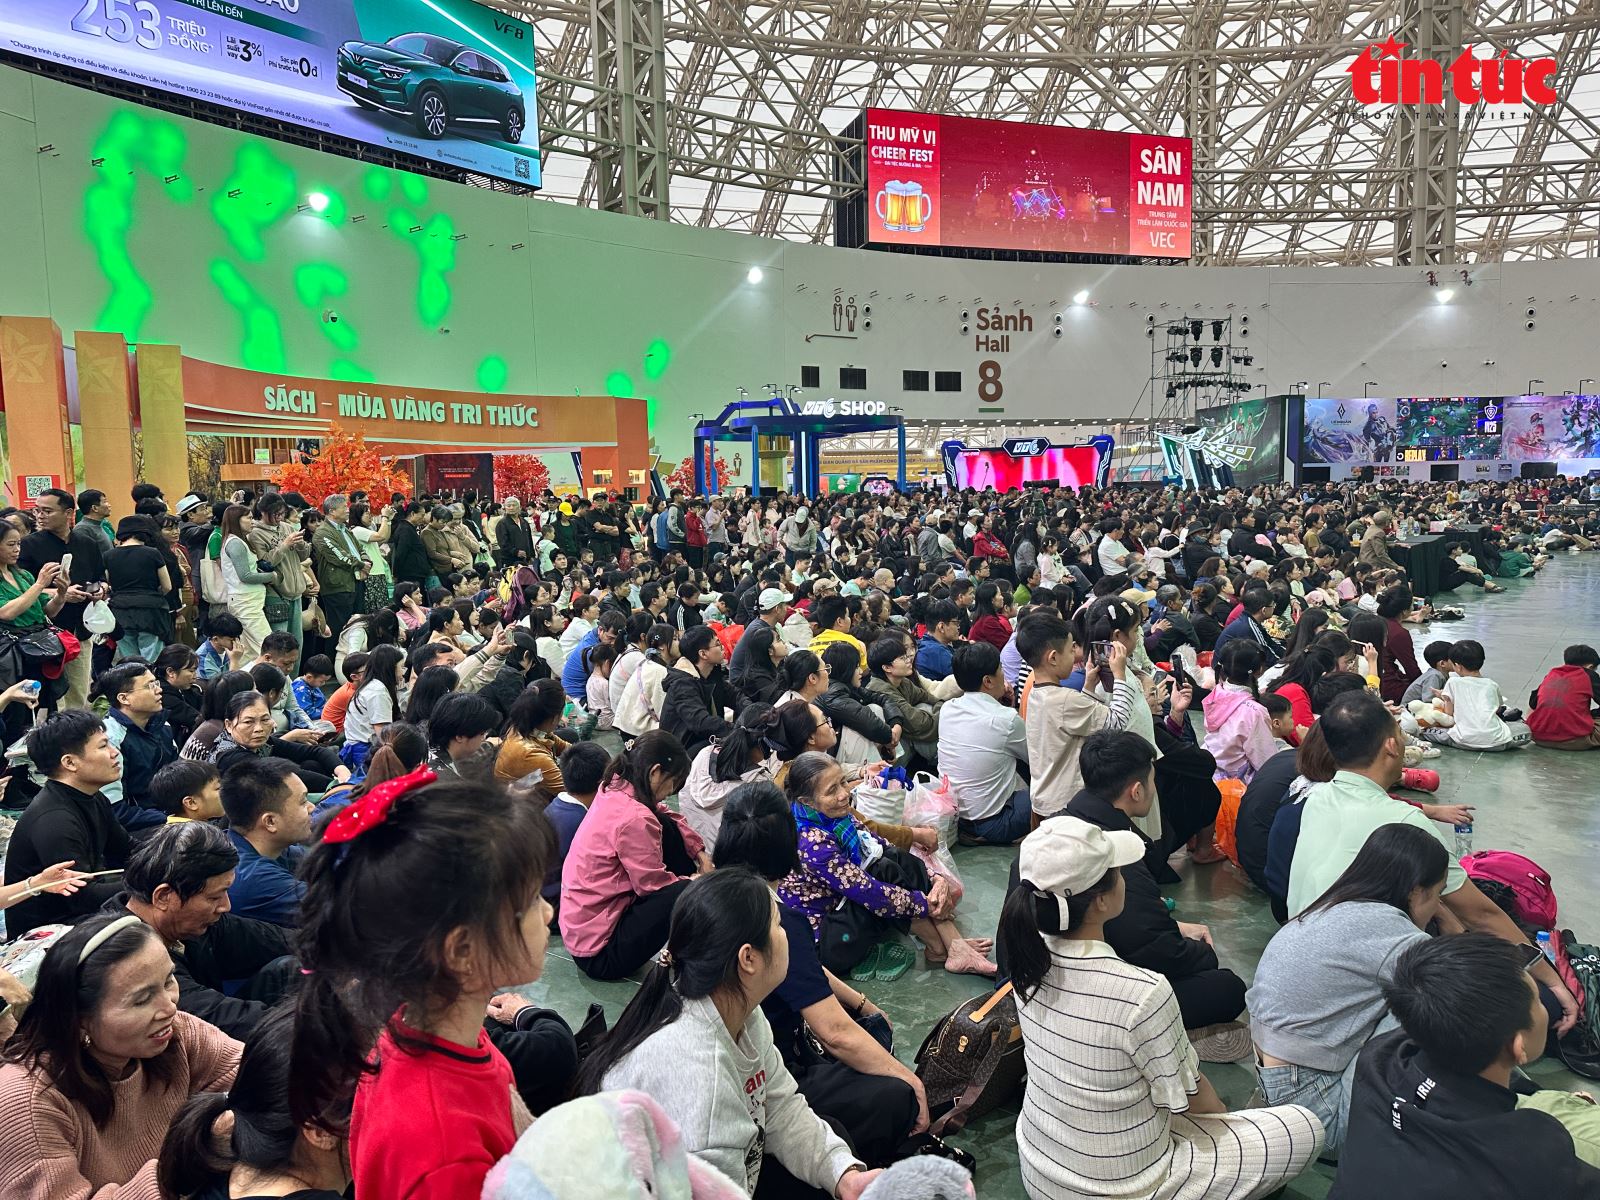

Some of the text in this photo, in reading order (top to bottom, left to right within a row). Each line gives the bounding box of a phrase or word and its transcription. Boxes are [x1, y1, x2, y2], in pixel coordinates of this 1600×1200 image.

[225, 6, 243, 19] ĐẾN
[71, 0, 163, 50] 253
[166, 15, 206, 37] TRIỆU
[227, 51, 239, 59] vay
[186, 86, 199, 95] 1900
[869, 124, 937, 146] THU MỸ VỊ
[871, 145, 934, 162] CHEER FEST
[1140, 145, 1181, 176] SÂN
[1137, 181, 1184, 207] NAM
[1149, 210, 1177, 219] TRUNG TÂM
[1164, 219, 1178, 228] QUỐC
[1149, 231, 1176, 249] VEC
[976, 306, 1033, 332] Sảnh
[975, 335, 1009, 352] Hall
[978, 360, 1003, 402] 8
[263, 383, 316, 414] SÁCH
[338, 391, 386, 420] MÙA
[390, 395, 445, 423] VÀNG
[451, 403, 482, 425] TRI
[487, 403, 539, 428] THỨC
[840, 400, 886, 416] SHOP
[1416, 1077, 1436, 1100] IRIE
